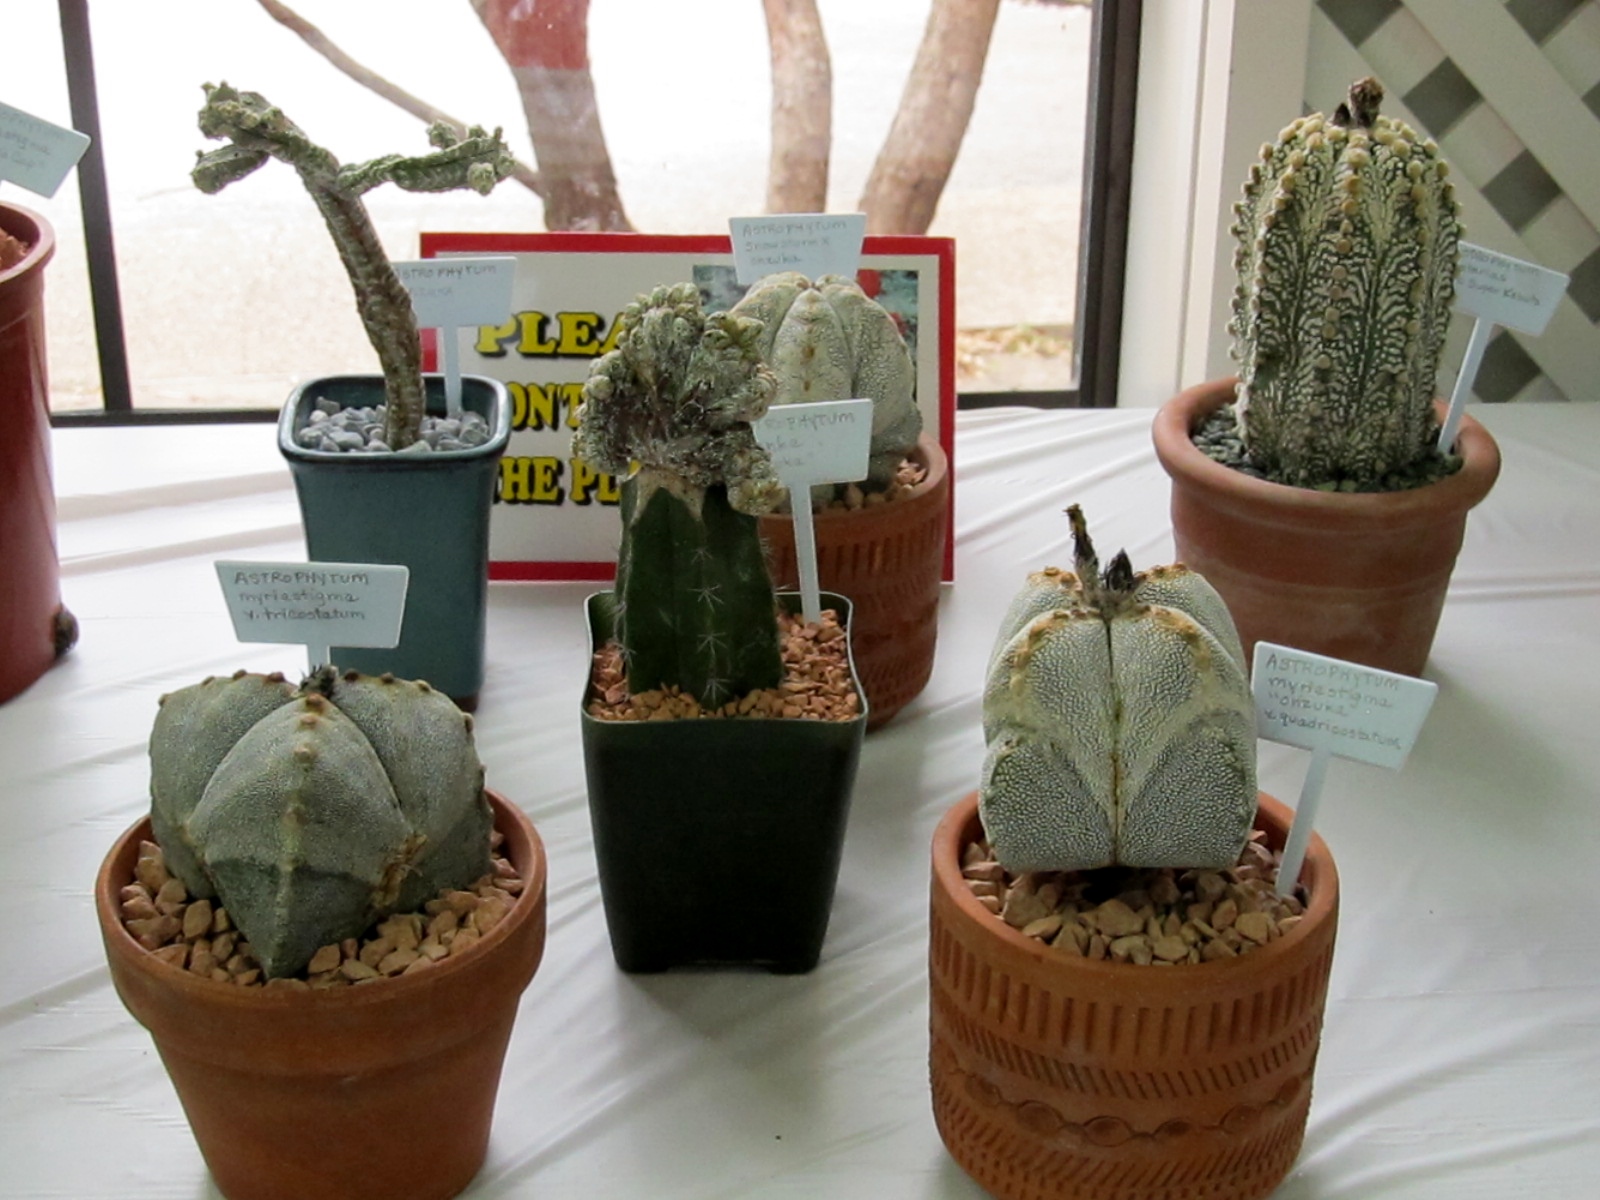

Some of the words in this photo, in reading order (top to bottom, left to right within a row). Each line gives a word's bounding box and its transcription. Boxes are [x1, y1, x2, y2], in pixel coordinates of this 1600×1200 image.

[495, 456, 564, 505] HE
[233, 571, 369, 587] ASTROPHYTUM
[1265, 652, 1401, 692] ASTROPHYTUM
